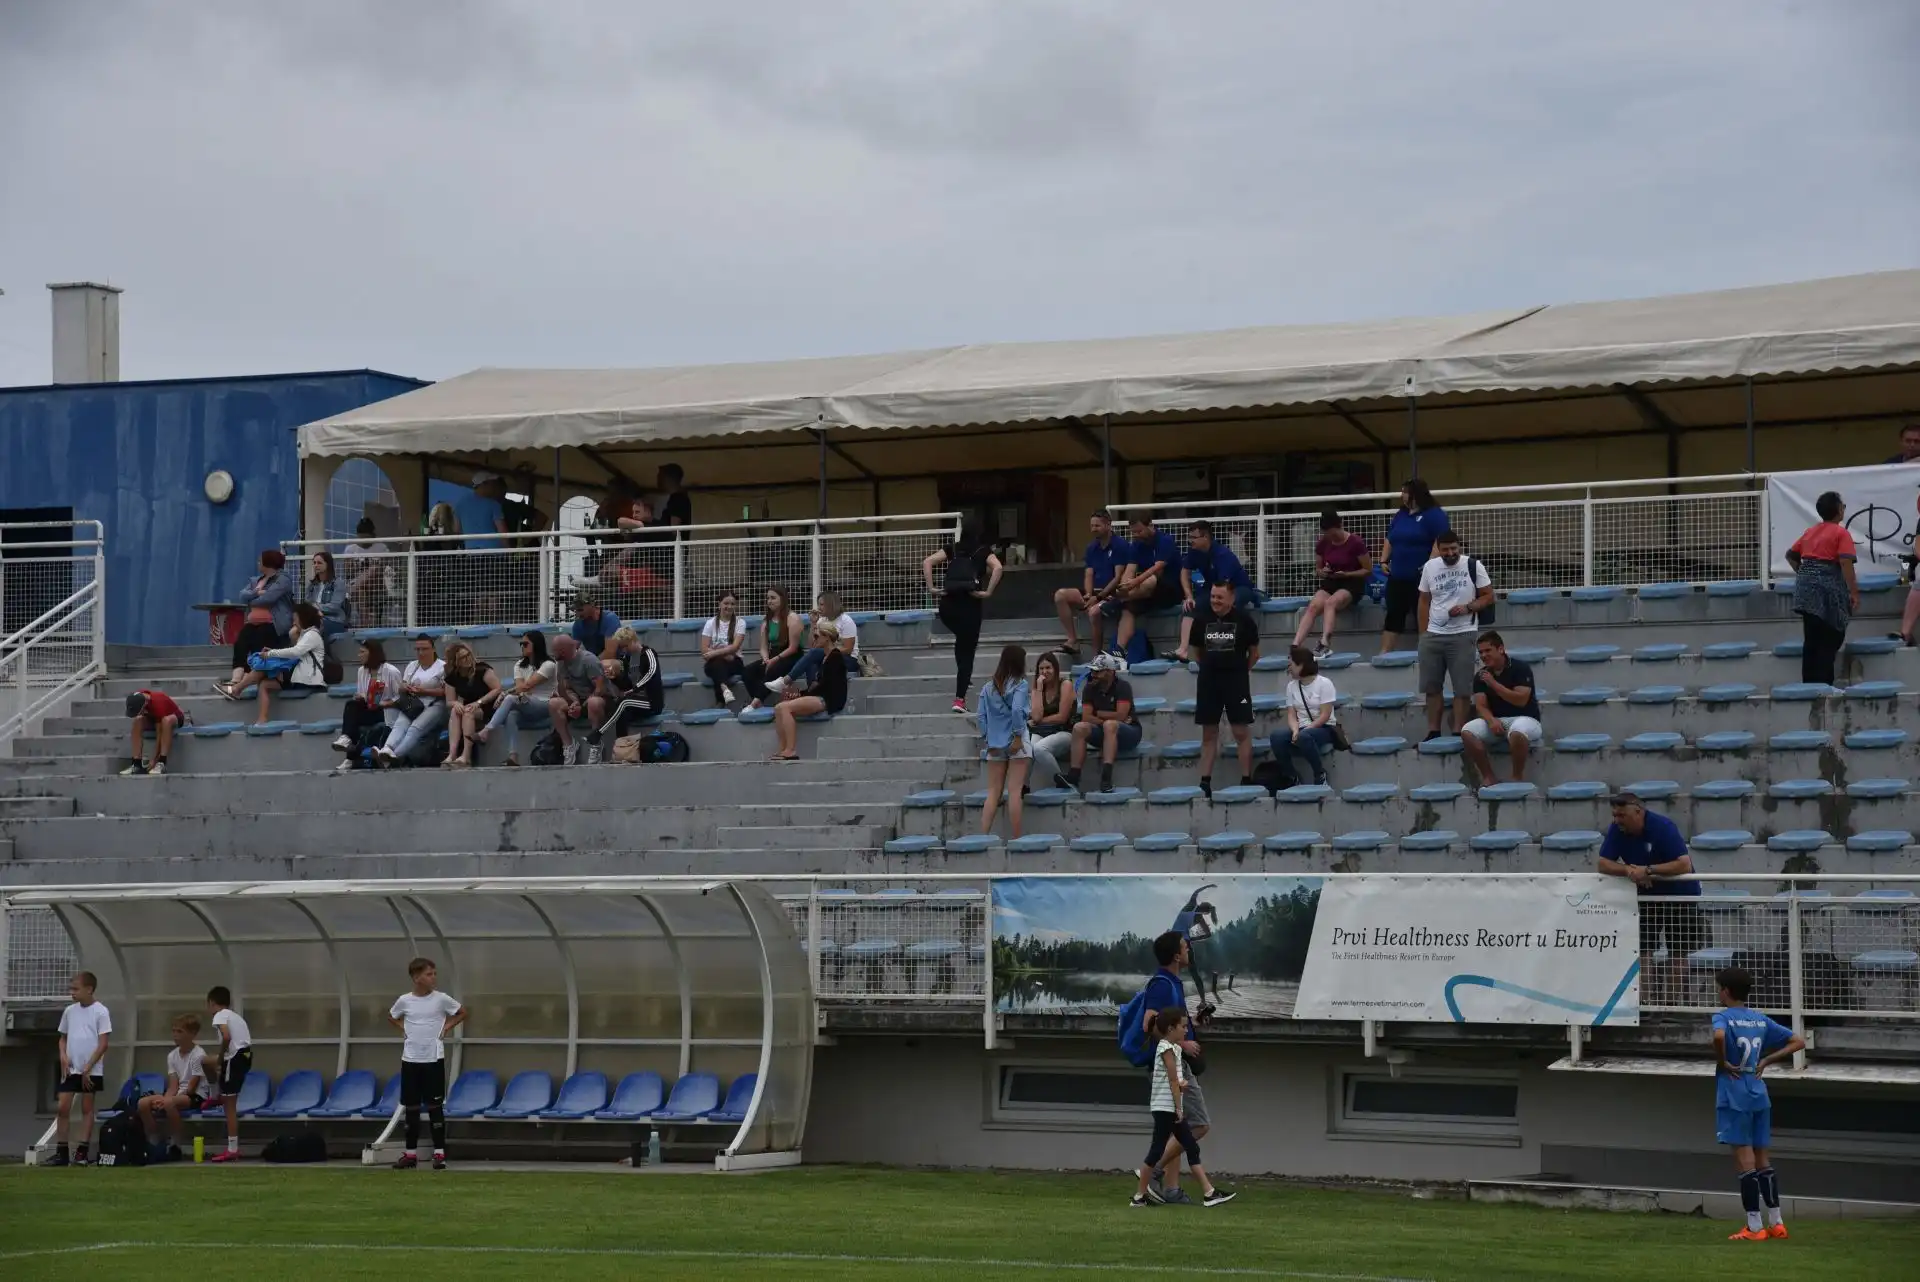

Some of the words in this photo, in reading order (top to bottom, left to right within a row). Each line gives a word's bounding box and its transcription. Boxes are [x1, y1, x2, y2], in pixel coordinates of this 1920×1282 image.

[1434, 573, 1447, 582] TOM
[1206, 631, 1234, 640] adidas
[1331, 927, 1367, 946] Prvi
[1373, 926, 1470, 947] Healthness
[1475, 928, 1532, 947] Resort
[1536, 933, 1548, 948] u
[1553, 929, 1618, 953] Europi
[1331, 951, 1342, 961] The
[1343, 951, 1359, 961] First
[1361, 951, 1398, 961] Healthness
[1399, 952, 1421, 962] Resort
[1422, 952, 1430, 961] in
[1431, 953, 1456, 963] Europe
[1331, 999, 1426, 1008] www.termesvetimartin.com
